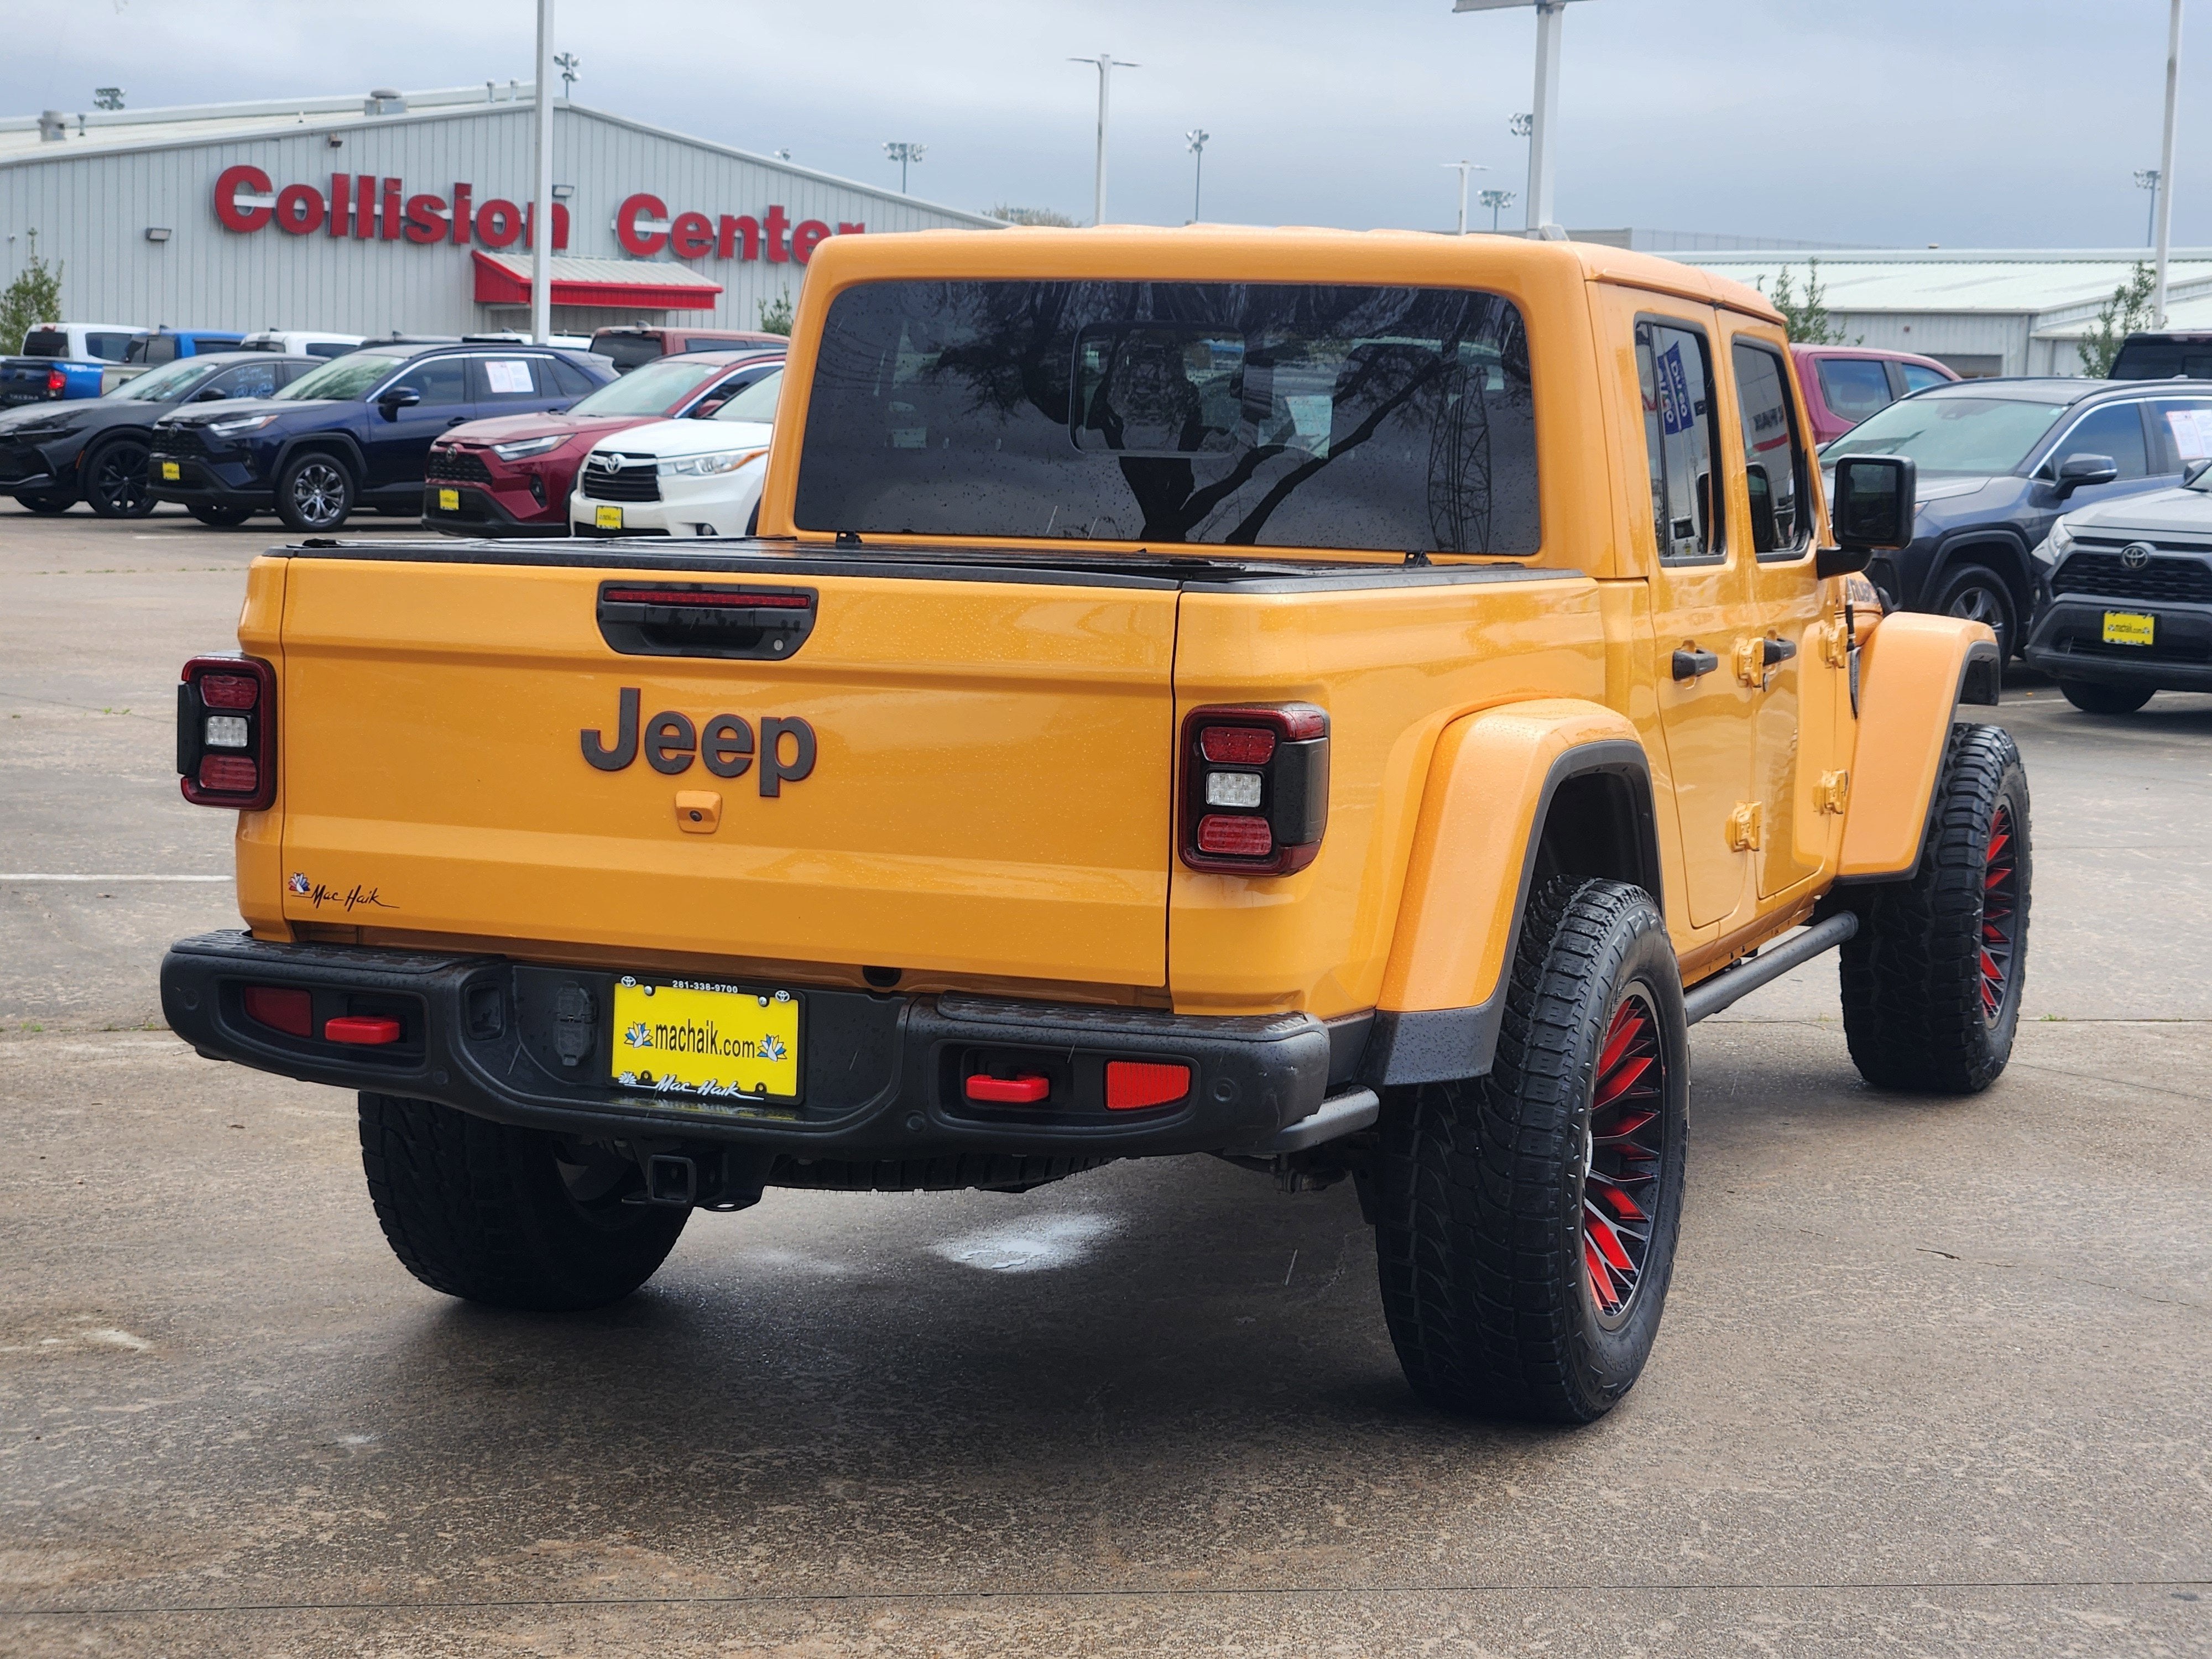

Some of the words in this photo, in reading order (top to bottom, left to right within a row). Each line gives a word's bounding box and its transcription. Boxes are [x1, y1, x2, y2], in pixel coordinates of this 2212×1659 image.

[214, 165, 570, 250] Collision
[617, 192, 865, 264] Cente
[581, 687, 817, 797] Jeep
[310, 884, 344, 909] Mac
[344, 884, 400, 912] Haik
[672, 979, 739, 994] 281-338-9700
[655, 1018, 755, 1059] machaik.com
[651, 1074, 697, 1093] Mac
[697, 1078, 765, 1101] Haik
